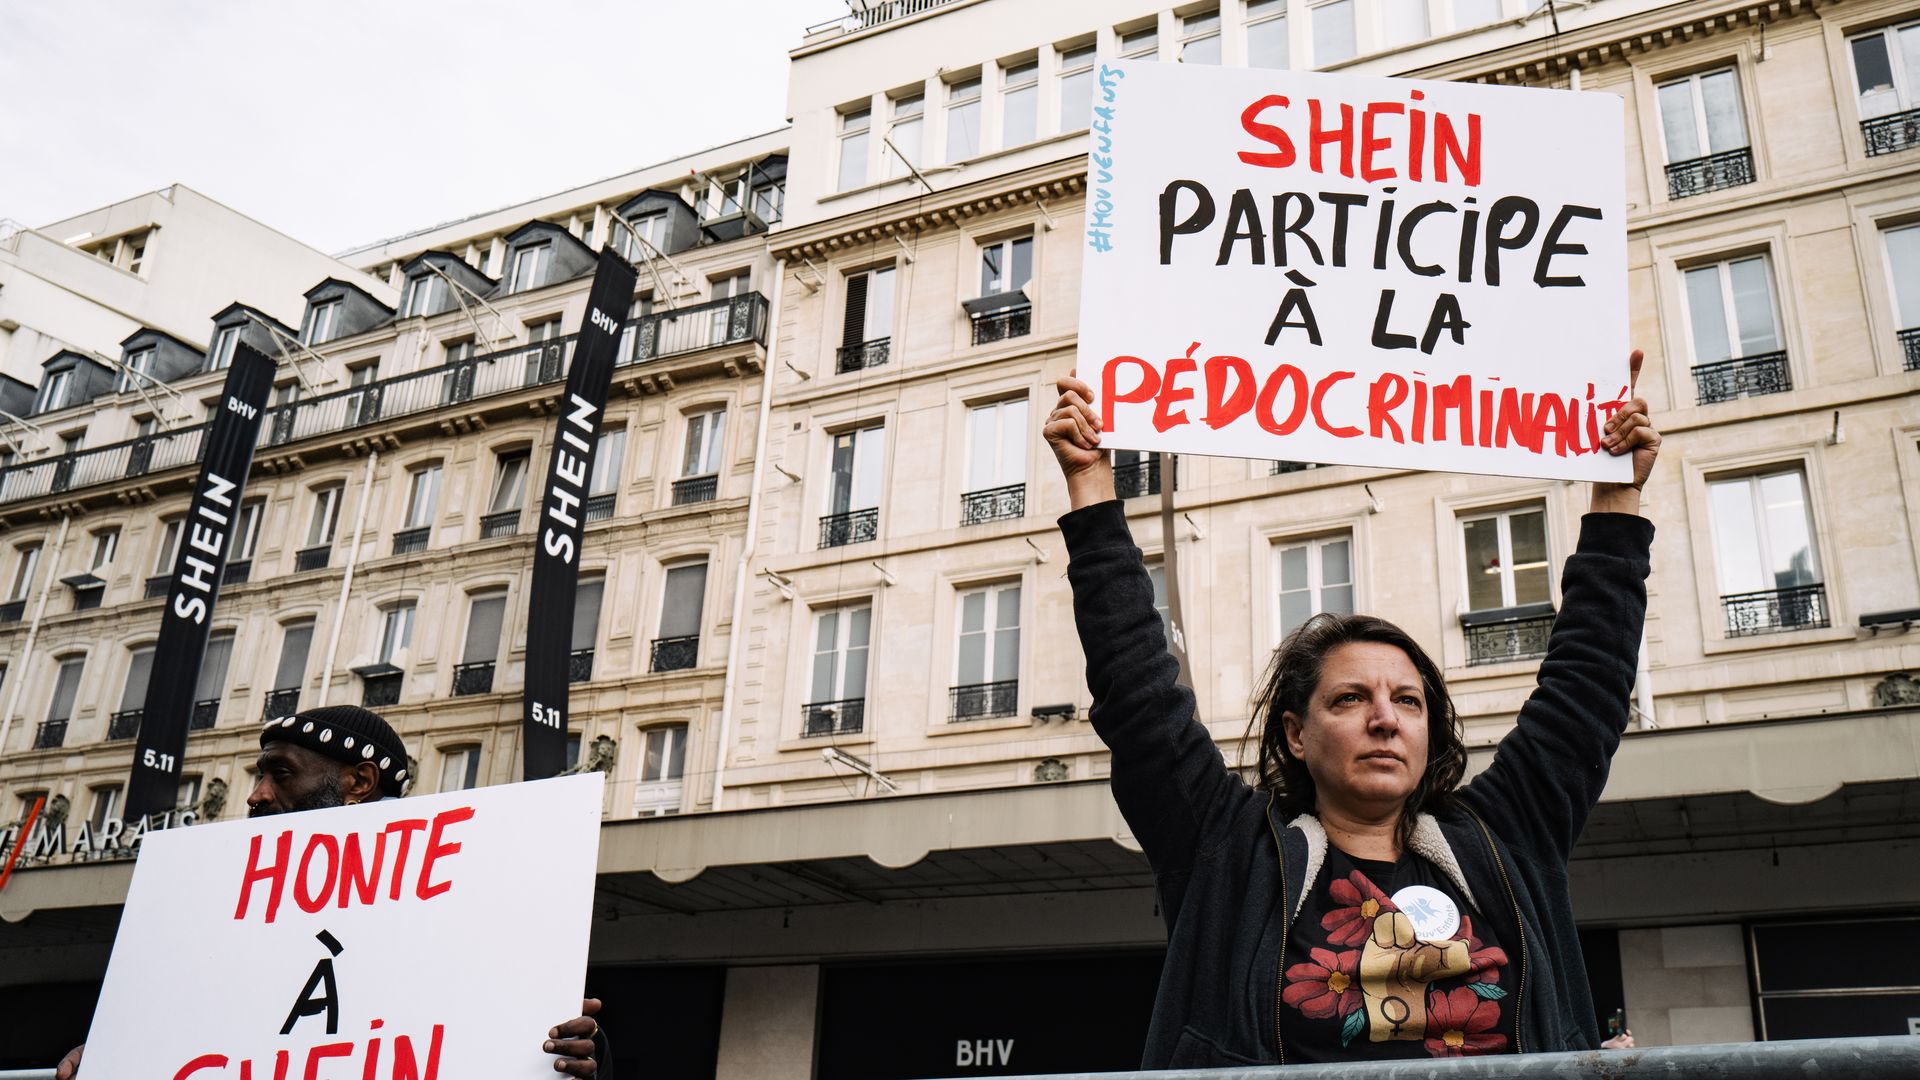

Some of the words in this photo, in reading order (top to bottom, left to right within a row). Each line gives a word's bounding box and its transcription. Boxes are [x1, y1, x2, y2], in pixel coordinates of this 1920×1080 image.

[1237, 89, 1481, 186] SHEIN
[1159, 180, 1602, 287] PARTICIPE
[591, 308, 618, 335] BHV
[1265, 270, 1322, 346] À
[1372, 289, 1471, 354] LA
[228, 397, 257, 420] BHV
[545, 393, 598, 564] SHEIN
[174, 472, 237, 624] SHEIN
[144, 749, 174, 772] 5.11
[532, 702, 561, 729] 5.11
[235, 807, 474, 923] HONTE
[280, 929, 344, 1034] À
[956, 1039, 1014, 1066] BHV
